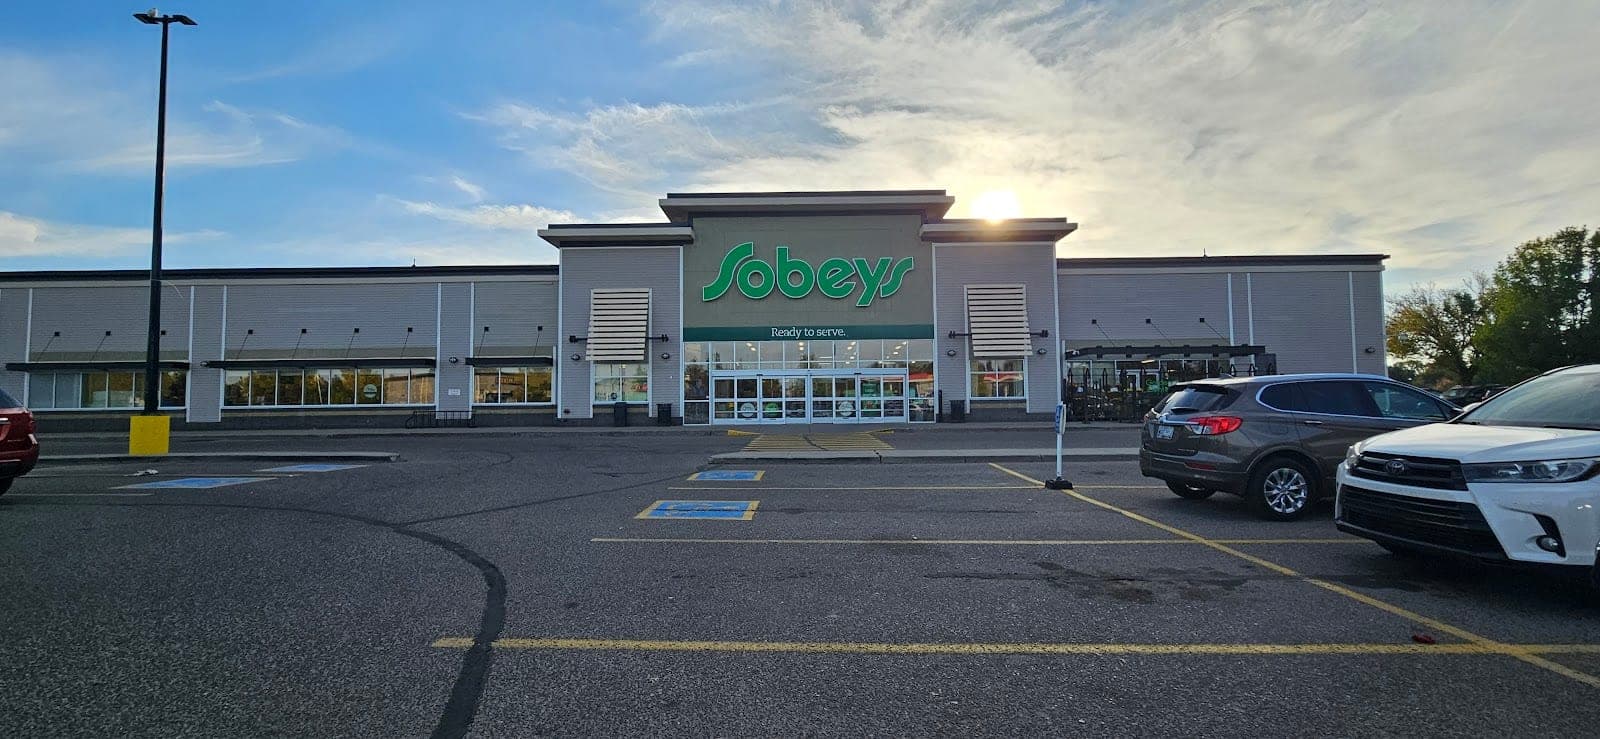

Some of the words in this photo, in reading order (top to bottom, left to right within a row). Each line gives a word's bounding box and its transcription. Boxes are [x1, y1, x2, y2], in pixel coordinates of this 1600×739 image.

[702, 241, 914, 307] Sobeys
[771, 326, 801, 340] Ready
[804, 327, 815, 337] to
[816, 328, 846, 337] serve.
